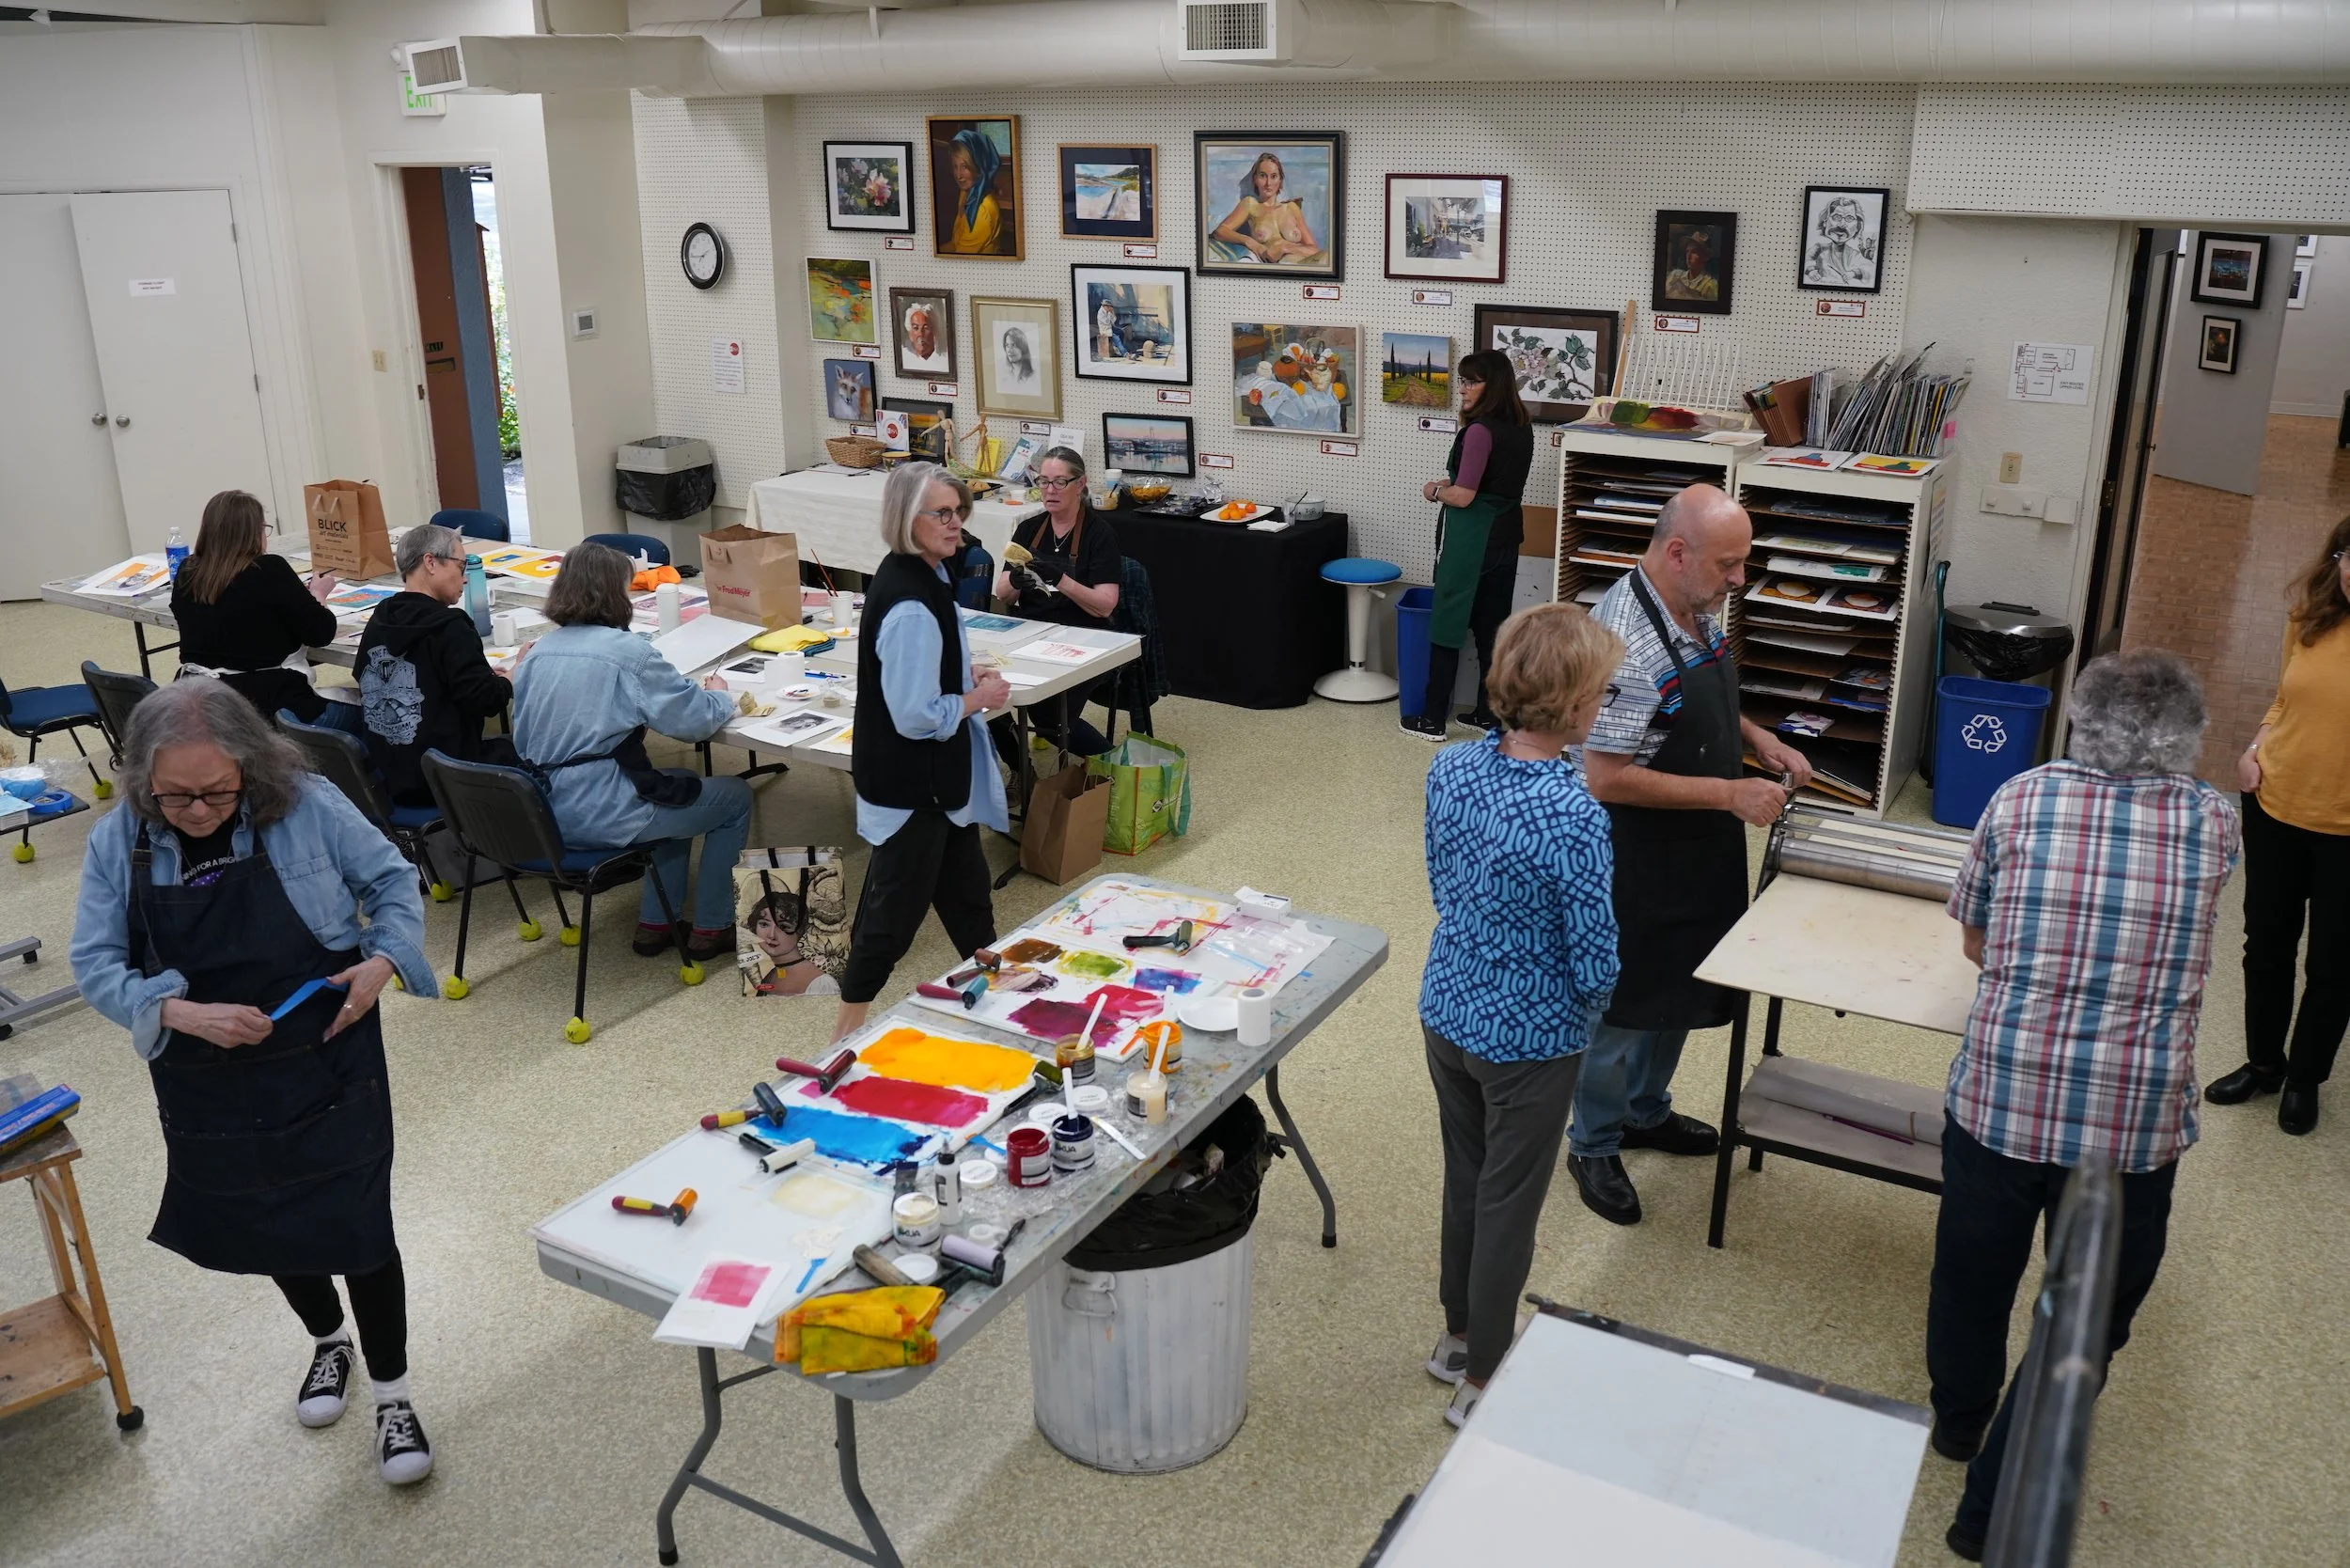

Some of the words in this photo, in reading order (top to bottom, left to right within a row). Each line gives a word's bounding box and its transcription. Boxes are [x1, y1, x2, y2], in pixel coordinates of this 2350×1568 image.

[318, 518, 347, 533] BLICK
[196, 860, 212, 872] FOR
[212, 858, 218, 867] A
[218, 856, 236, 866] BRIG
